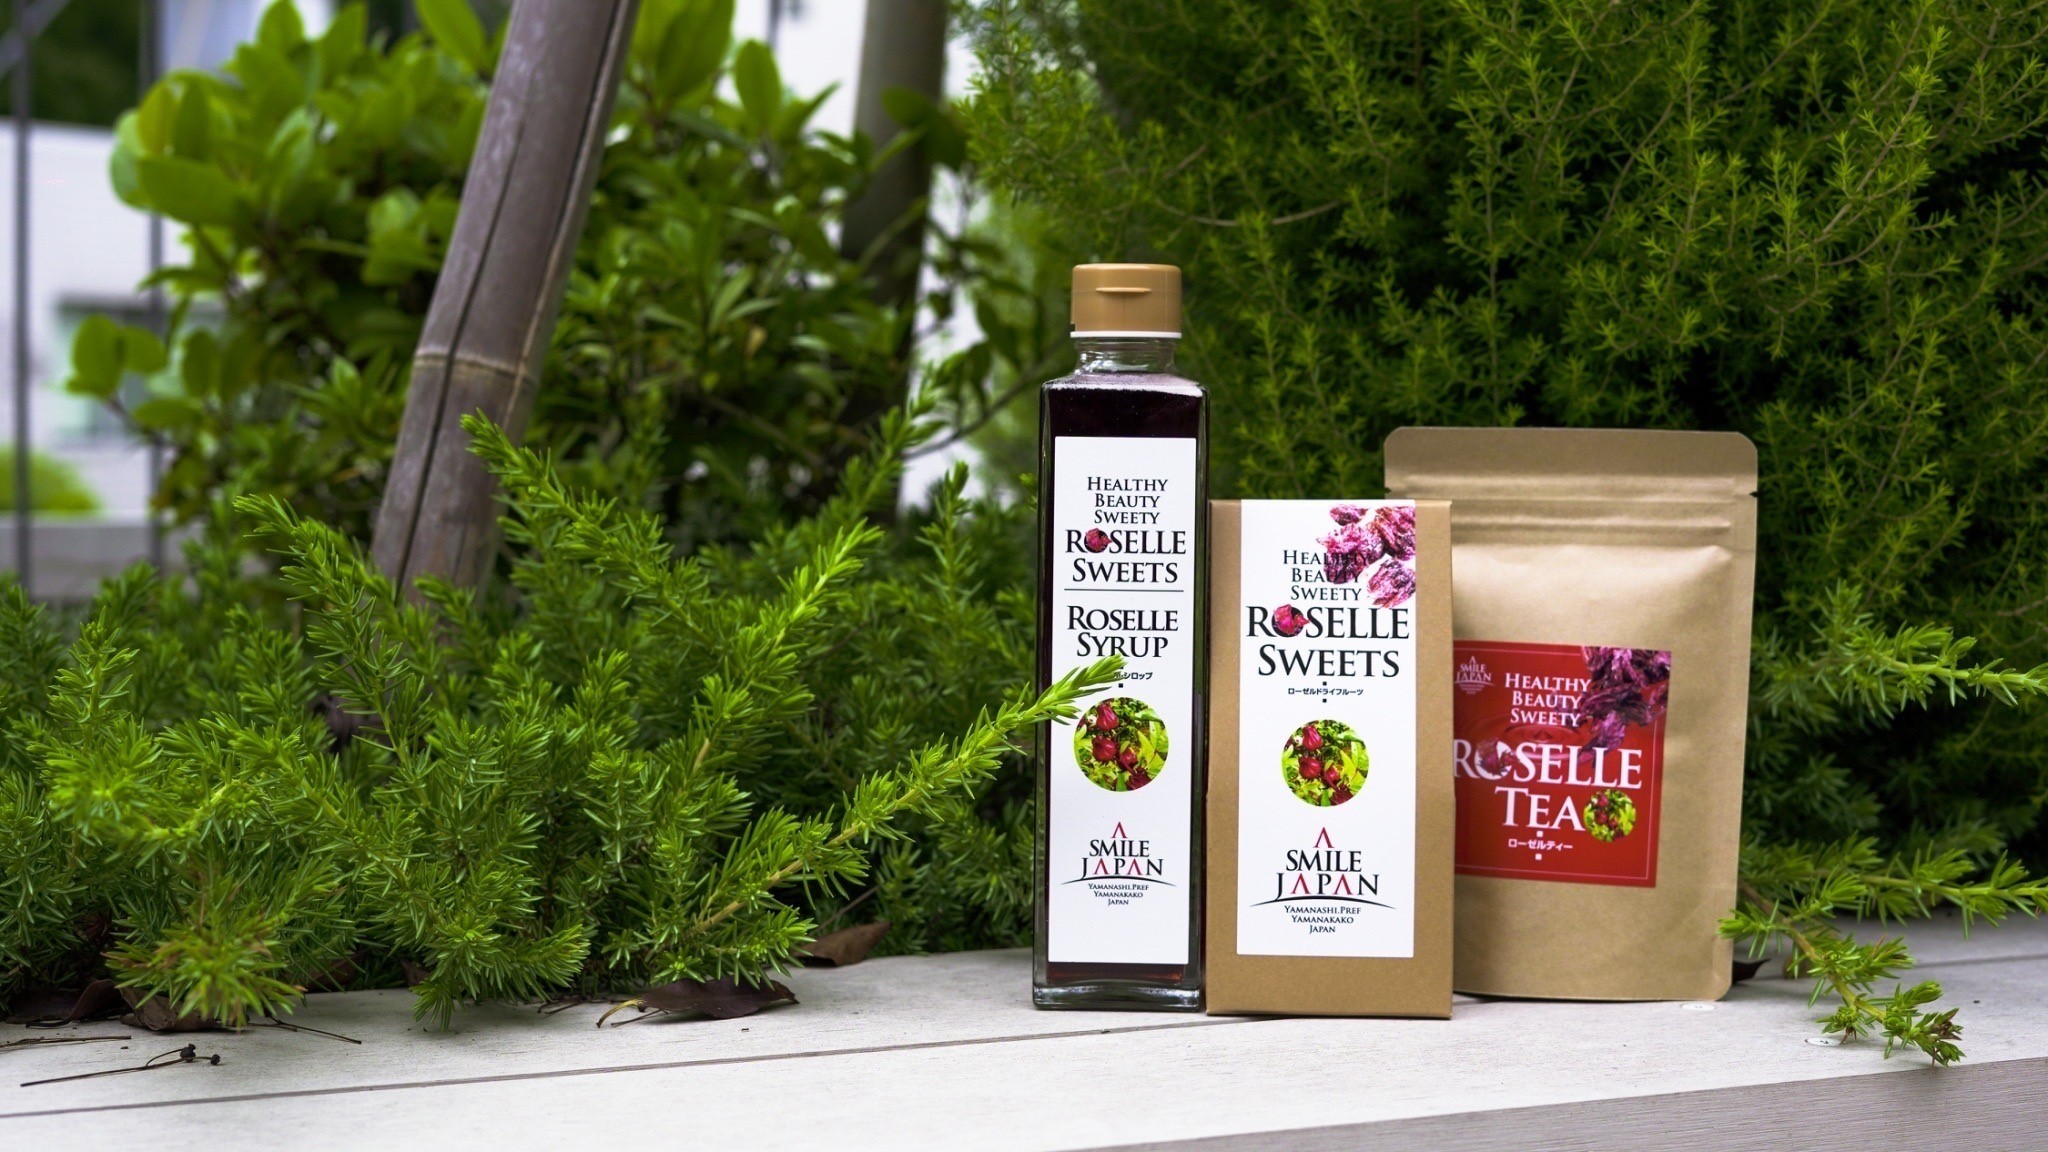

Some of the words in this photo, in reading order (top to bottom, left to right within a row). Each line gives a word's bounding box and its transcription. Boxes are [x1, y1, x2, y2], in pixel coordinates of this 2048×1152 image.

[1087, 476, 1168, 492] HEALTHY
[1094, 493, 1160, 508] BEAUTY
[1094, 509, 1160, 524] SWEETY
[1065, 528, 1187, 555] ROSELLE
[1072, 557, 1178, 583] SWEETS
[1290, 585, 1362, 601] SWEETY
[1067, 605, 1179, 631] ROSELLE
[1246, 604, 1410, 639] ROSELLE
[1076, 631, 1169, 658] SYRUP
[1258, 644, 1400, 678] SWEETS
[1460, 663, 1487, 673] SMILE
[1456, 671, 1492, 682] JAPAN
[1505, 672, 1591, 692] HEALTHY
[1288, 687, 1364, 696] ローゼルドライフルーツ
[1511, 691, 1582, 710] BEAUTY
[1510, 708, 1581, 727] SWEETY
[1454, 738, 1643, 789] ROSELLE
[1494, 786, 1586, 832] TEA
[1111, 821, 1128, 839] A
[1313, 827, 1335, 848] A
[1089, 839, 1150, 857] SMILE
[1508, 838, 1573, 851] ローゼルティー
[1082, 857, 1164, 879] JAPAN
[1286, 849, 1362, 872] SMILE
[1093, 890, 1144, 898] YAMANAKAKO
[1276, 872, 1379, 900] JAPAN
[1107, 898, 1129, 906] JAPAN
[1291, 914, 1354, 924] YAMANAKAKO
[1309, 924, 1336, 934] JAPAN
